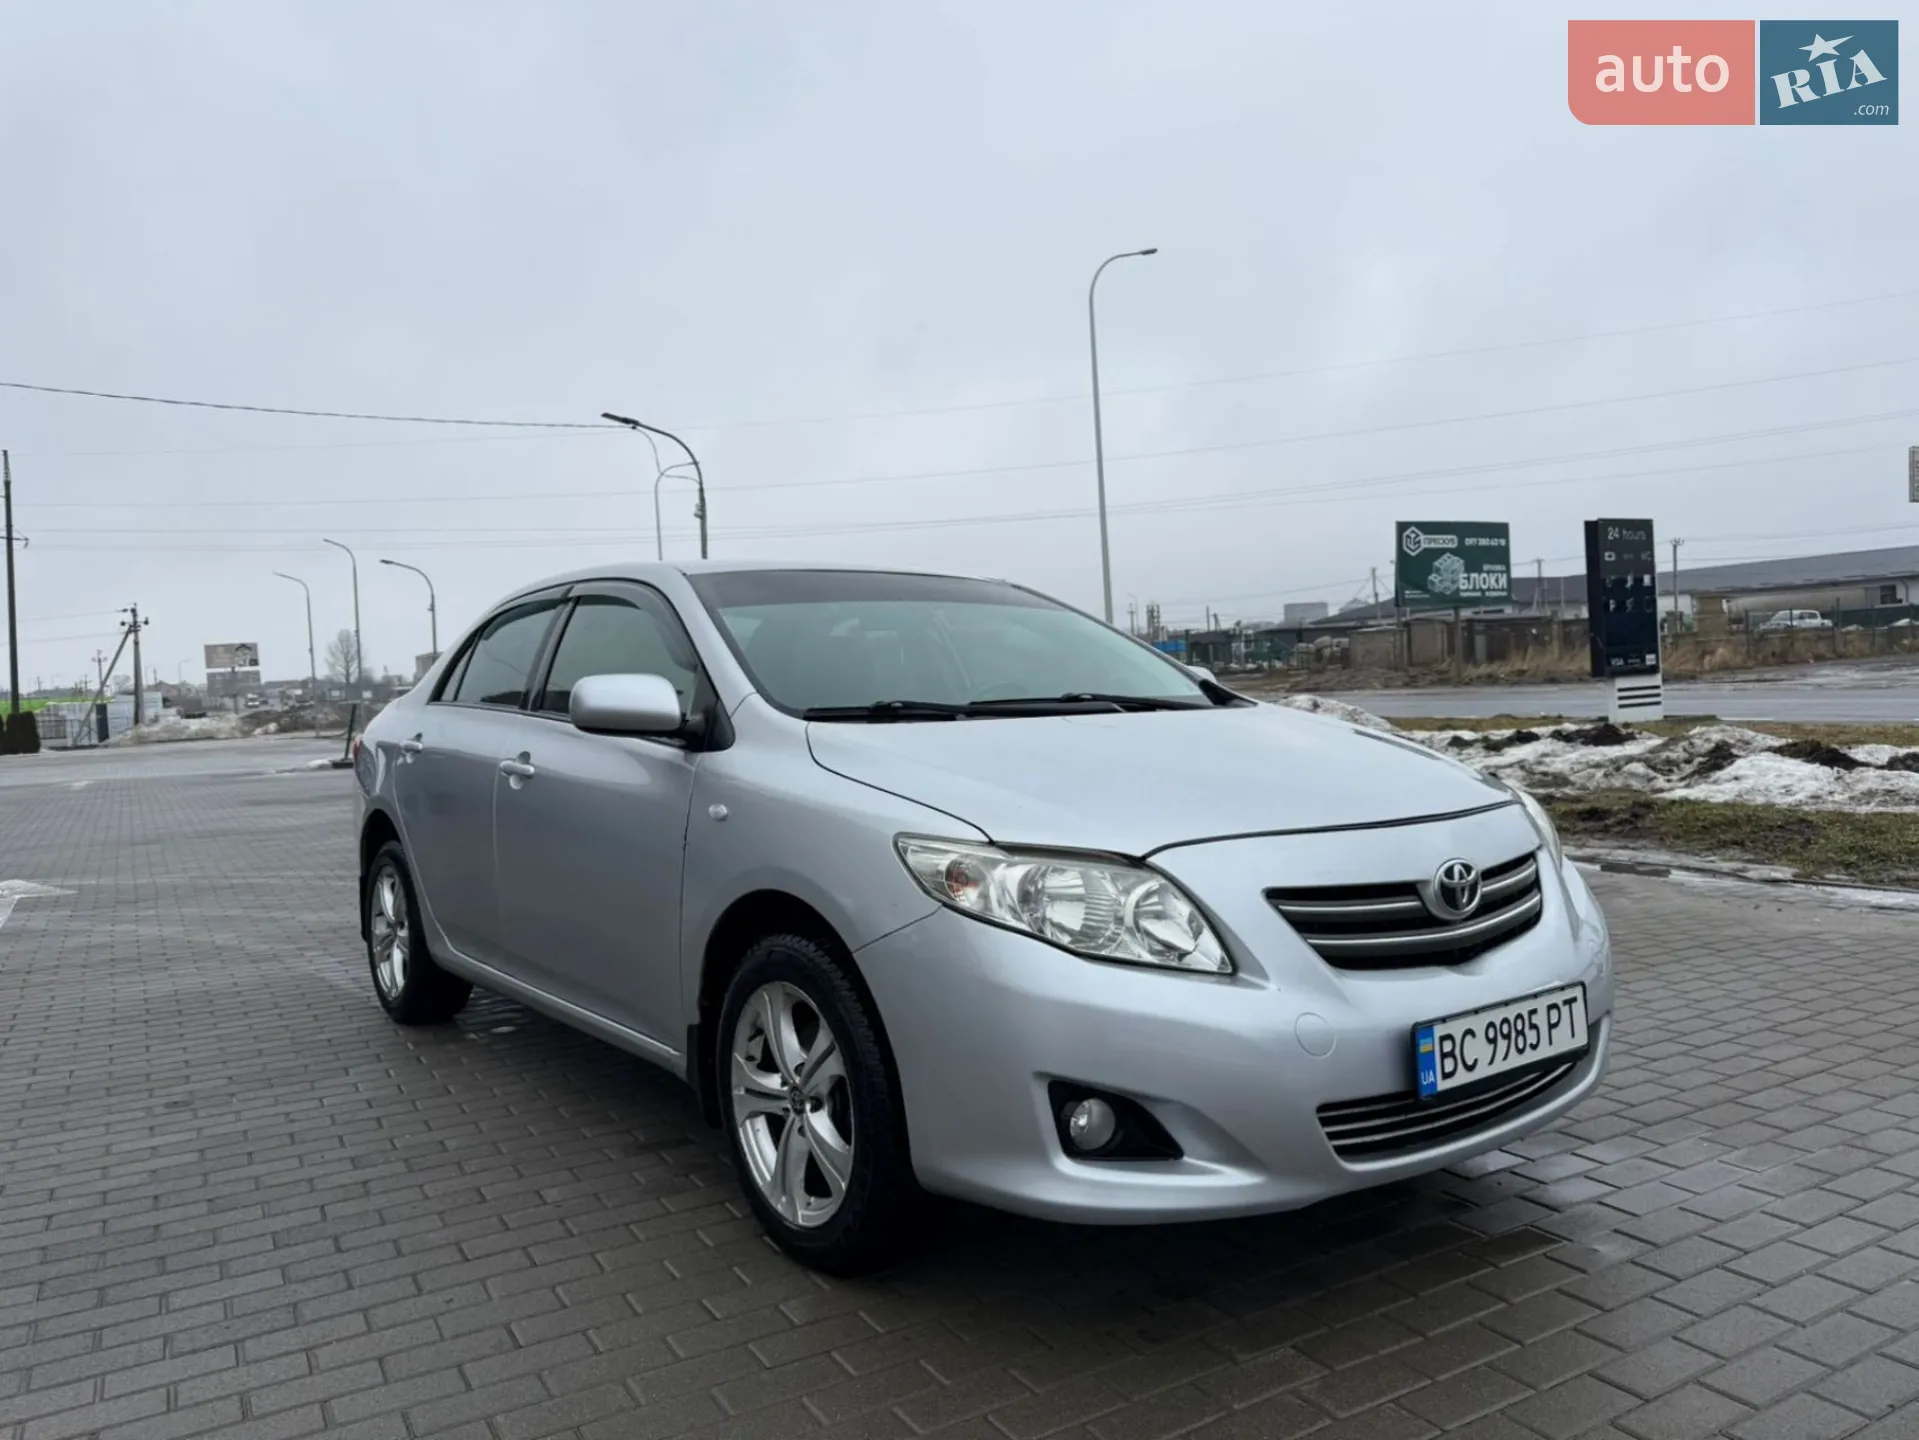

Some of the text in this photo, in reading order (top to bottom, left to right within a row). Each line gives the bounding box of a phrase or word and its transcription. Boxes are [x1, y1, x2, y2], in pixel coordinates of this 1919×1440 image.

[1607, 526, 1647, 540] 24 hours
[1459, 572, 1507, 590] БЛОКИ
[1438, 996, 1578, 1081] BC 9985 PT
[1421, 1070, 1436, 1085] UA
